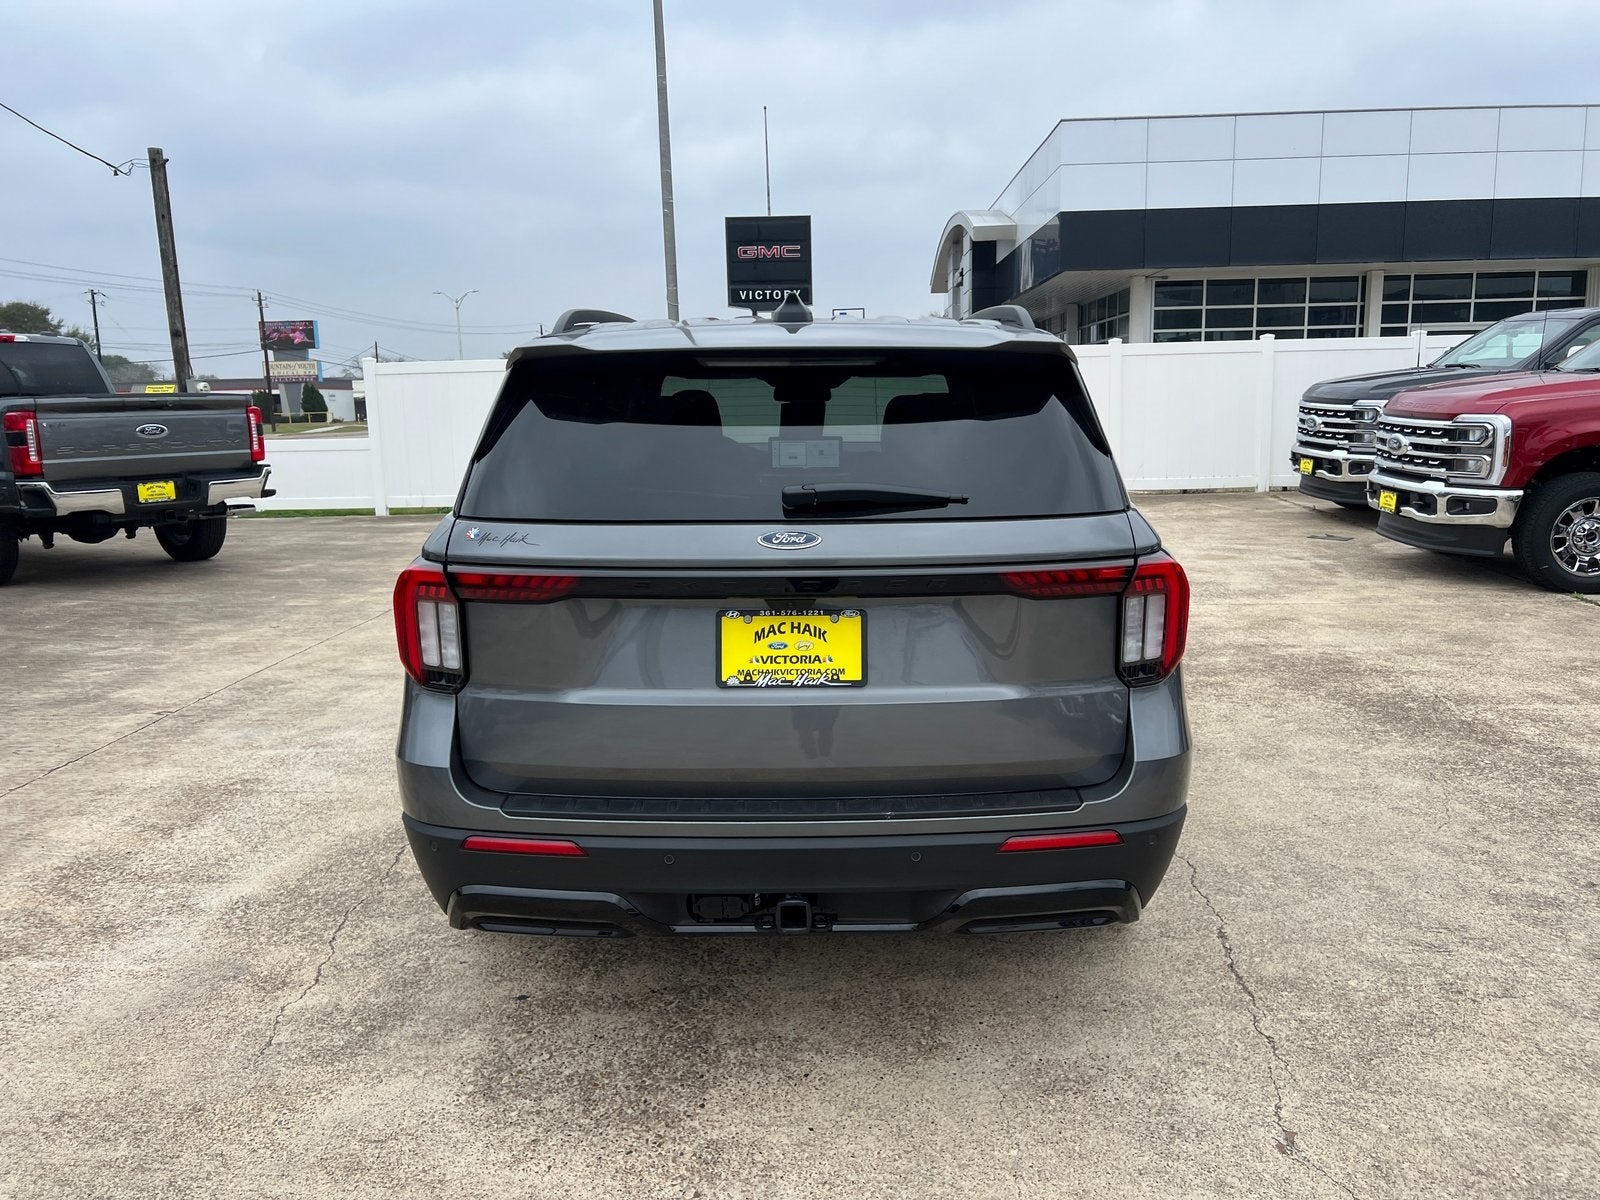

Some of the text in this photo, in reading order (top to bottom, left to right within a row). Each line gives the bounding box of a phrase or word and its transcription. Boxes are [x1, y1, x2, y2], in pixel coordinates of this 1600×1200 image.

[737, 245, 801, 258] GMC
[772, 533, 807, 544] Ford
[754, 622, 827, 643] MAC HAIK
[760, 655, 822, 664] VICTORIA
[754, 673, 837, 687] Mac Haik
